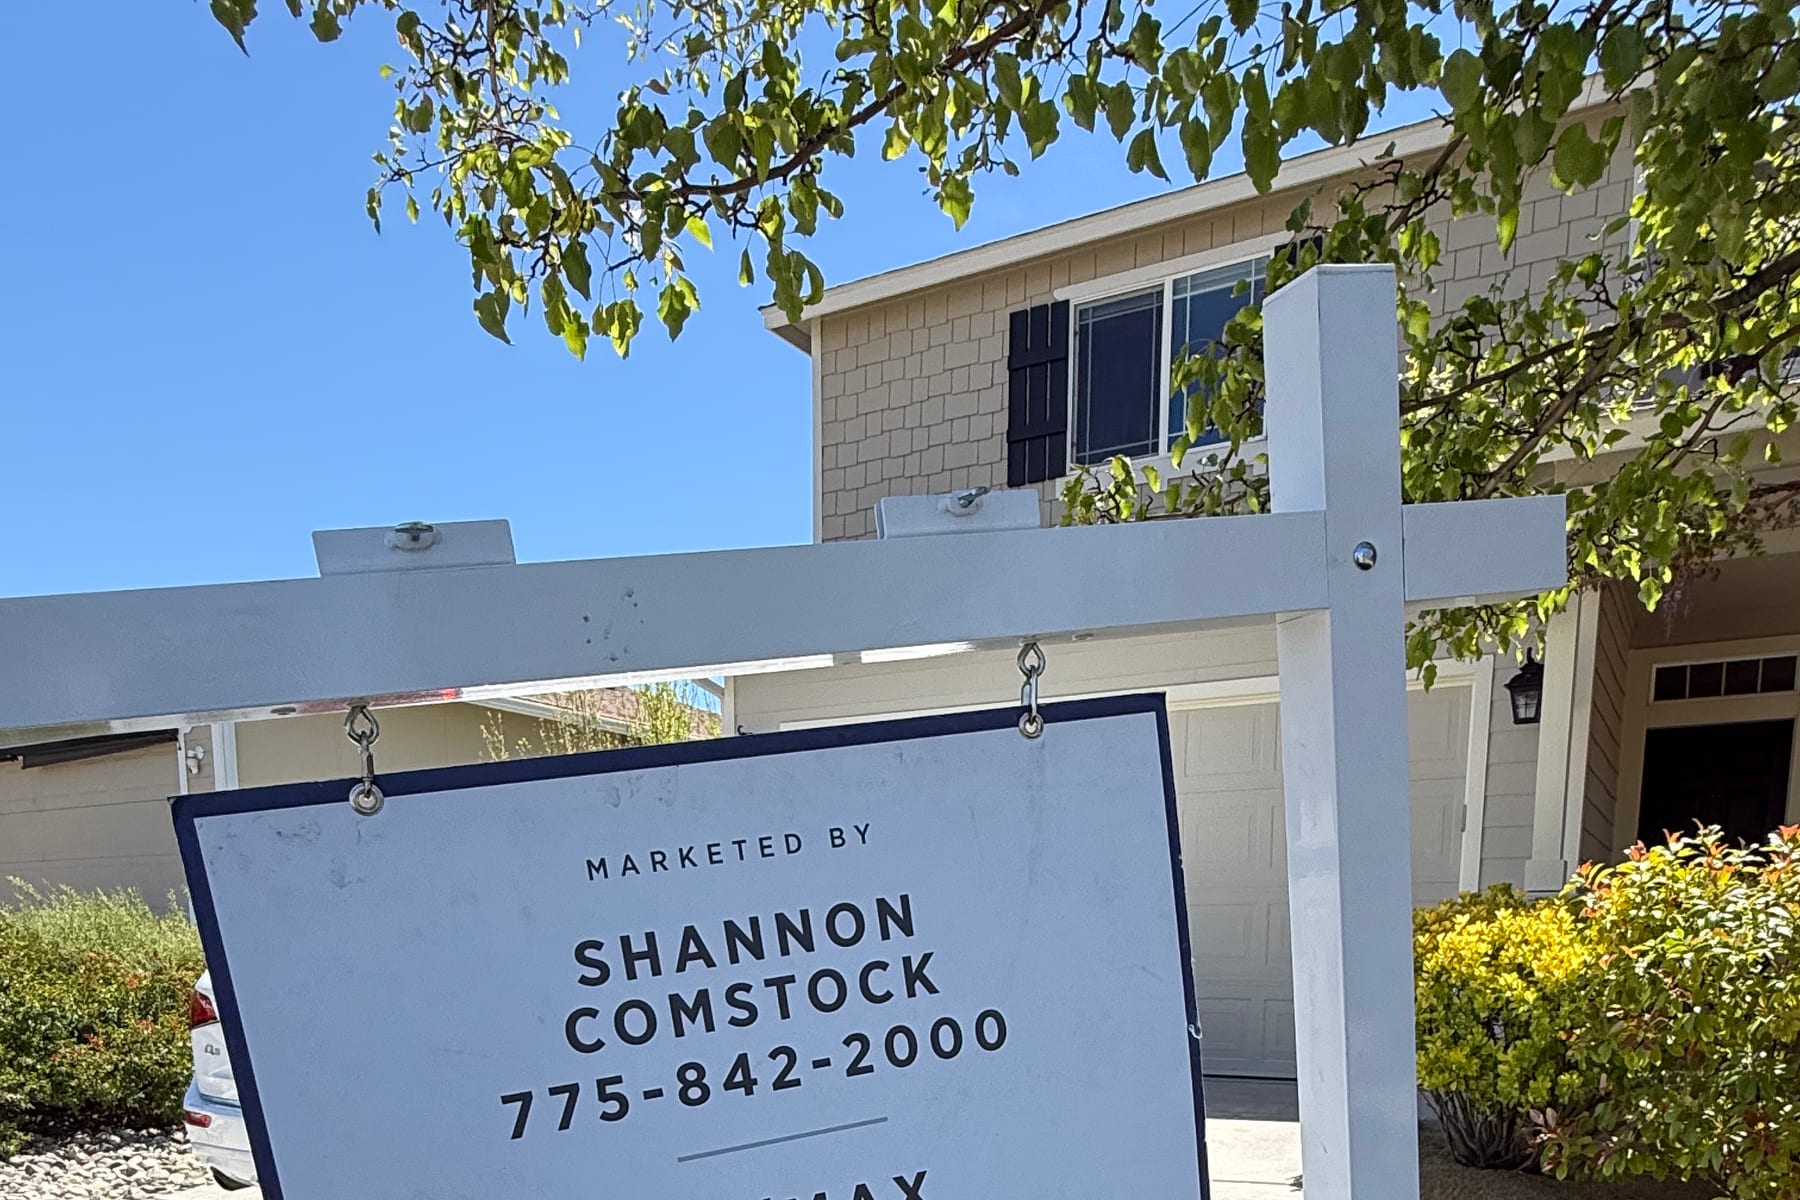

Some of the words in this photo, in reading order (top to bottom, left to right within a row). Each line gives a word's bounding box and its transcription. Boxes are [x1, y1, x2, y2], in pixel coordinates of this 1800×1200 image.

[586, 831, 803, 881] MARKETED
[829, 823, 873, 849] BY
[573, 893, 916, 987] SHANNON
[565, 951, 940, 1054] COMSTOCK
[501, 1009, 1007, 1140] 775-842-2000
